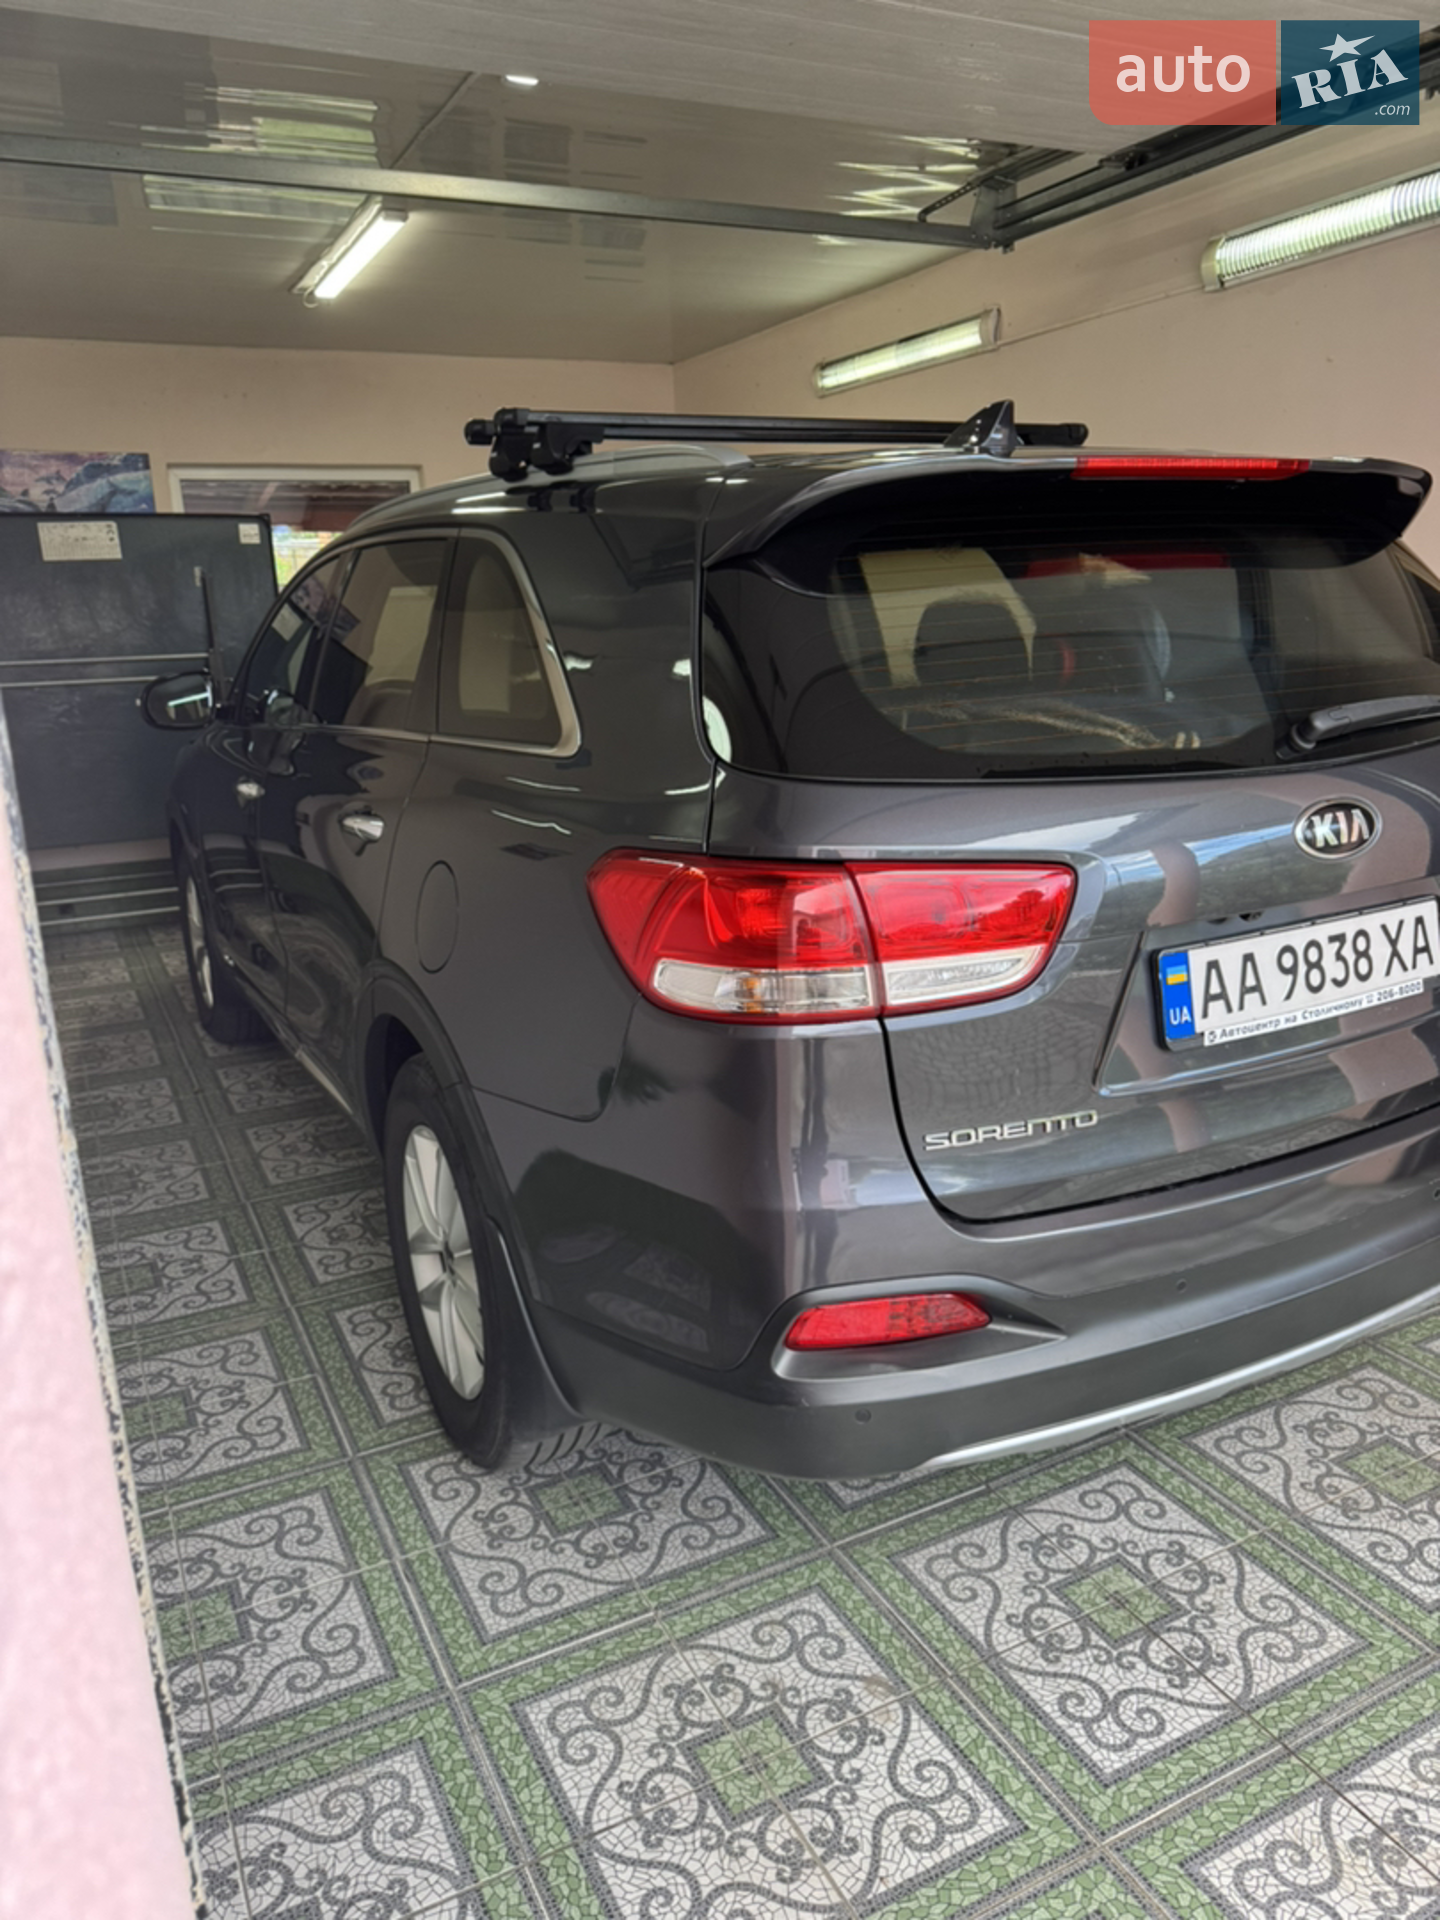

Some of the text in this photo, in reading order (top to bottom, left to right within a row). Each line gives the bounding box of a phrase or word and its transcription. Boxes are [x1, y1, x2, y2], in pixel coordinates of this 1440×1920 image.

[1310, 808, 1369, 848] KIA
[1201, 915, 1434, 1020] AA 9838 XA
[1169, 1006, 1191, 1025] UA
[1219, 1017, 1281, 1039] Автоцентр
[1284, 1016, 1297, 1025] на
[1301, 998, 1363, 1020] Столичному
[925, 1110, 1098, 1151] SORENTO
